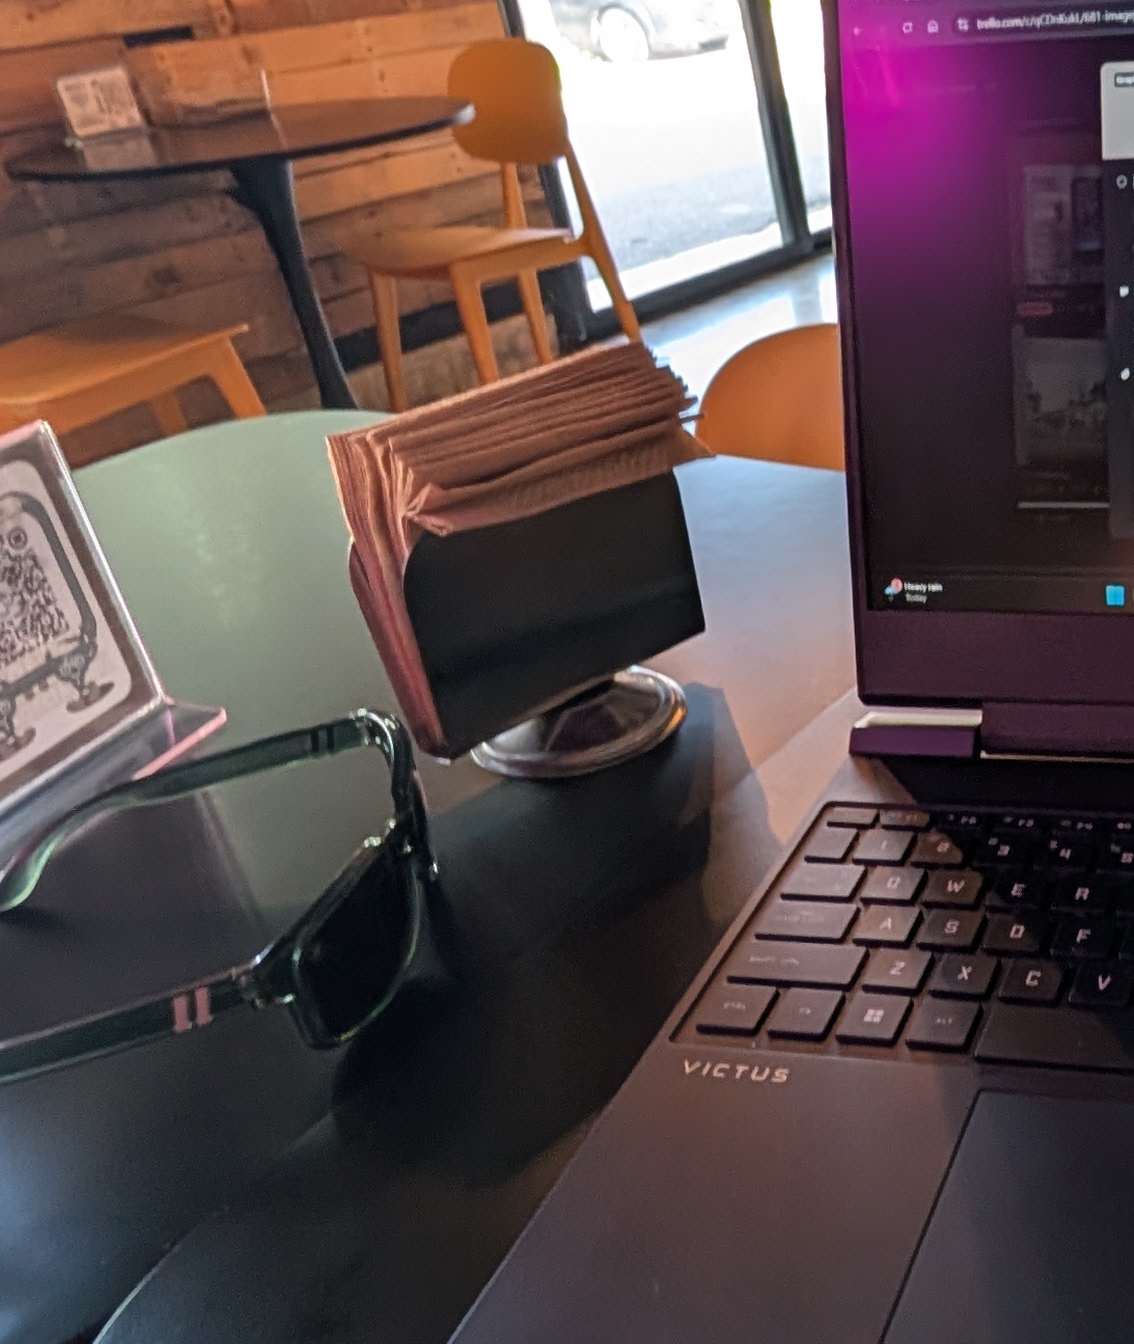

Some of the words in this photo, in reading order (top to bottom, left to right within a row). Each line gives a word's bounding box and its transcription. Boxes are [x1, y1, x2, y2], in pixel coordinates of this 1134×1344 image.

[946, 878, 966, 895] W
[1011, 882, 1027, 897] E
[1075, 886, 1091, 901] R
[943, 918, 960, 935] S
[1076, 927, 1092, 944] F
[889, 961, 906, 975] Z
[957, 964, 973, 981] X
[1025, 970, 1042, 987] C
[1097, 974, 1112, 991] V
[682, 1058, 791, 1084] VICTUS
